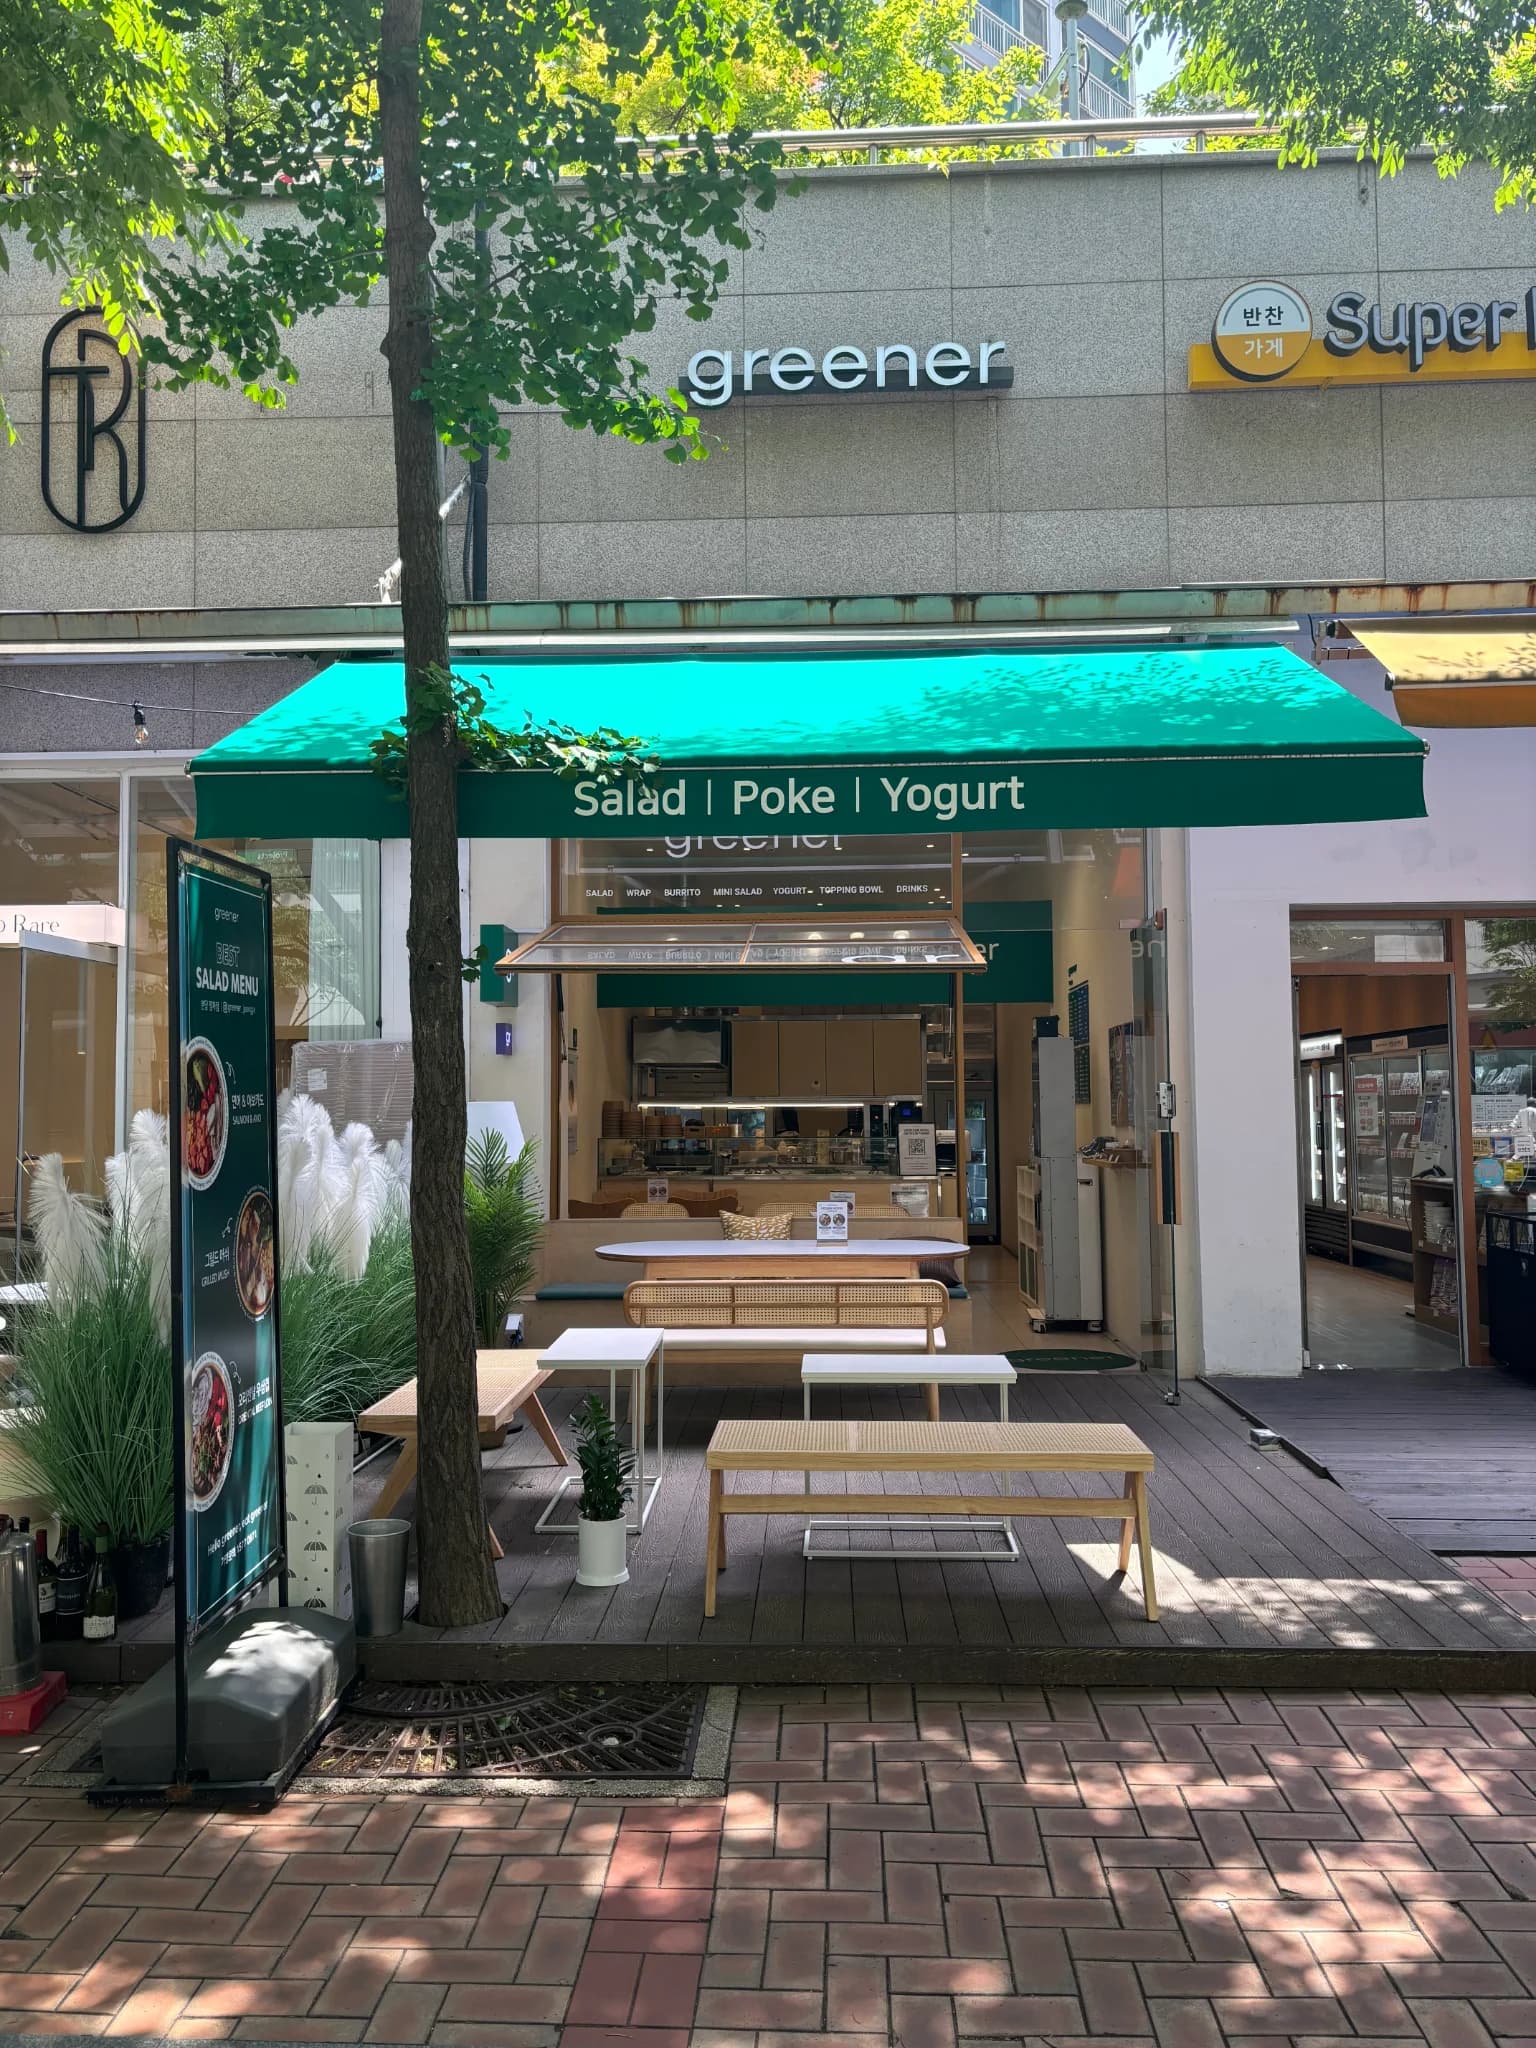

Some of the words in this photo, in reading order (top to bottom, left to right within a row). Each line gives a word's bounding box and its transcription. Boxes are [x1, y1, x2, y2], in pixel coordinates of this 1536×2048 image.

[1243, 305, 1284, 327] 반찬
[1325, 285, 1536, 371] Super
[1243, 336, 1284, 359] 가게
[687, 341, 1006, 406] greener
[573, 778, 686, 817] Salad
[733, 778, 836, 816] Poke
[880, 775, 1025, 821] Yogurt
[585, 889, 614, 897] SALAD
[626, 888, 651, 897] WRAP
[664, 888, 701, 897] BURRITO
[713, 887, 732, 896] MINI
[734, 887, 763, 896] SALAD
[773, 886, 807, 896] YOGURT
[819, 886, 857, 895] TOPPING
[859, 885, 884, 894] BOWL
[896, 884, 929, 894] DRINKS
[14, 913, 60, 934] Rare
[214, 907, 239, 923] greener
[216, 942, 240, 968] BEST
[196, 966, 230, 993] SALAD
[231, 972, 259, 996] MENU
